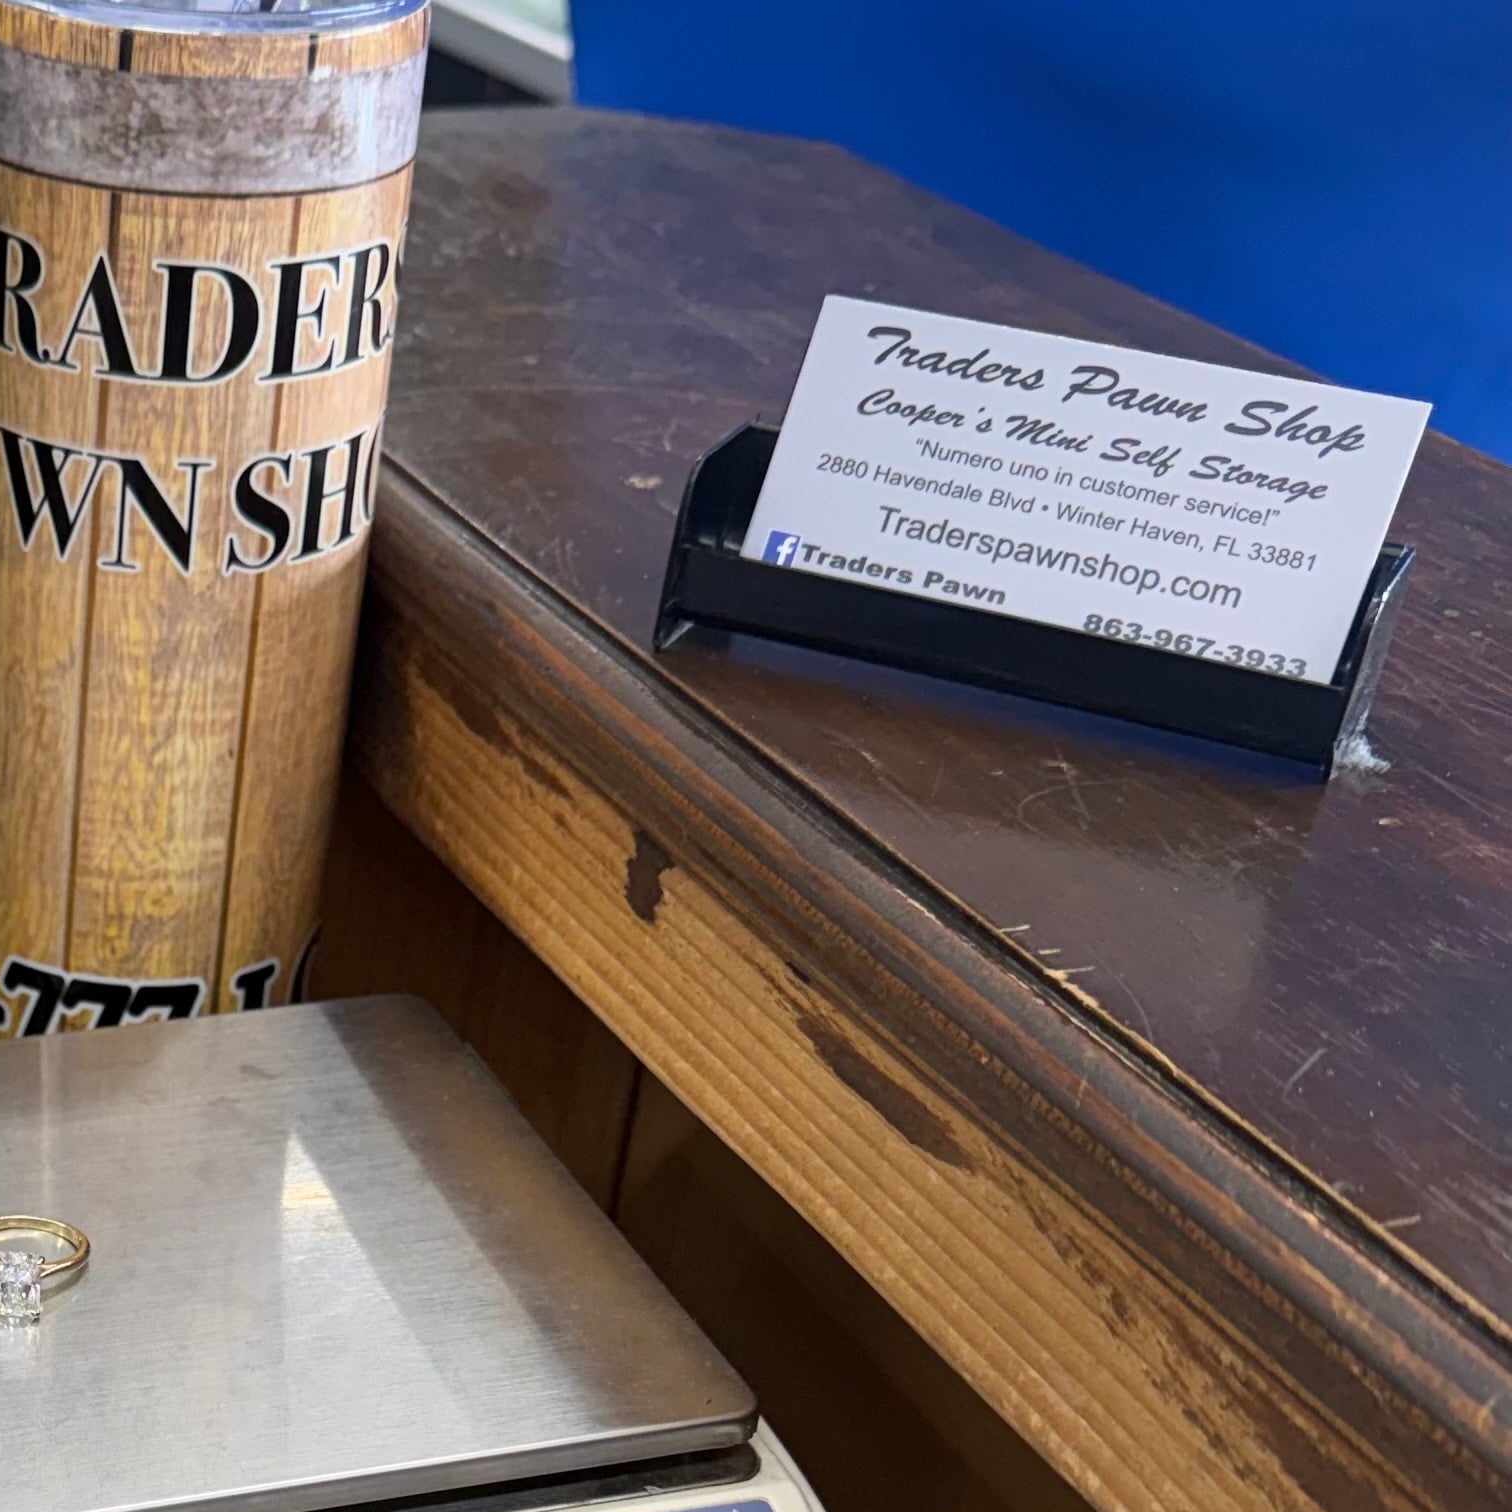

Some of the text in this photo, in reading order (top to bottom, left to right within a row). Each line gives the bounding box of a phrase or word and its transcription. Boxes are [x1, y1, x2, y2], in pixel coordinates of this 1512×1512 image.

[867, 326, 1366, 458] Traders Pawn Shop
[857, 388, 1329, 503] Cooper's Mini Self Storage
[1009, 463, 1049, 482] uno
[1054, 467, 1073, 486] in
[1080, 475, 1180, 507] customer
[817, 453, 1317, 572] 2880 Havendale Blvd Winter Haven, FL 33881
[879, 505, 1242, 609] Traderspawnshop.com
[801, 543, 913, 585] Traders
[923, 570, 1006, 605] Pawn
[1083, 614, 1307, 677] 863-967-3933
